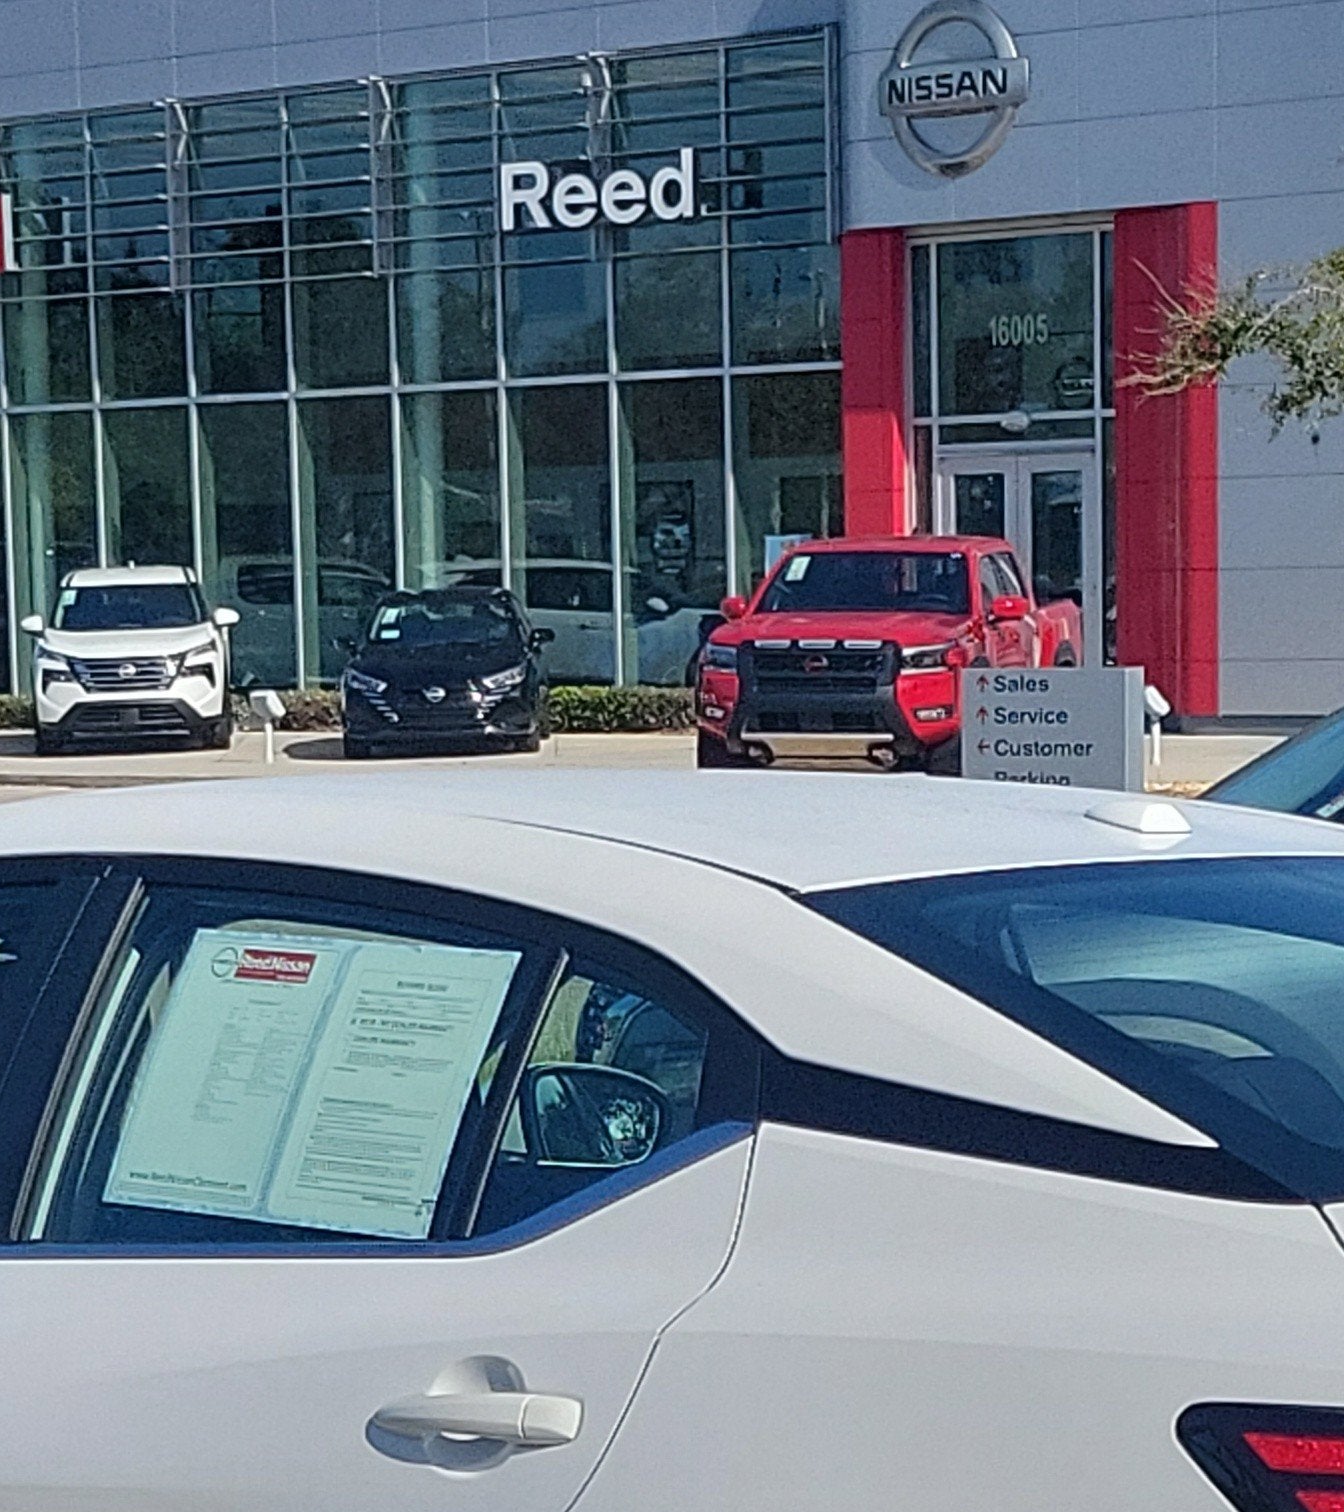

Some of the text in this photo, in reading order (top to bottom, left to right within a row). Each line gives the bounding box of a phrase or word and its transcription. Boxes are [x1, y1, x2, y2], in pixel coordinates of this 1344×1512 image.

[887, 66, 1009, 105] NISSAN
[499, 146, 695, 232] Reed
[988, 313, 1050, 348] 16005
[993, 674, 1050, 694] Sales
[993, 706, 1069, 725] Service
[993, 738, 1094, 757] Customer
